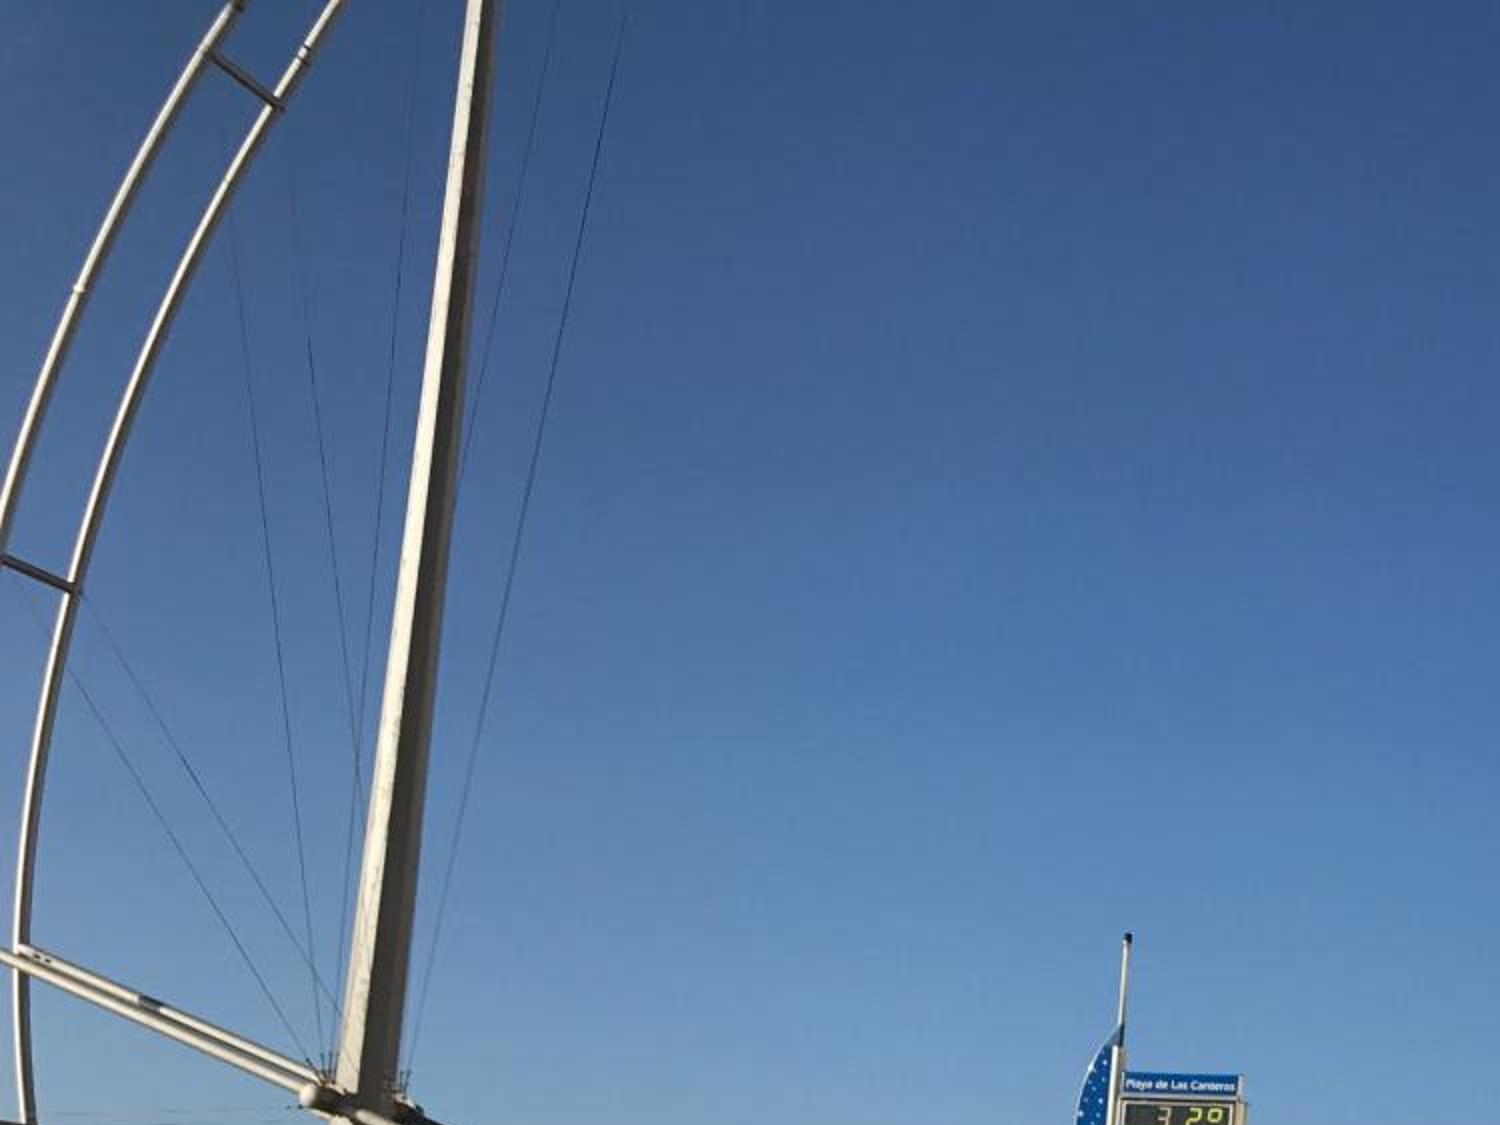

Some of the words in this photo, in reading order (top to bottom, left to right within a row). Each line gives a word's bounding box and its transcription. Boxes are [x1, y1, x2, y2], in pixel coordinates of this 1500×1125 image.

[1125, 1079, 1153, 1092] Playa
[1155, 1079, 1168, 1090] de
[1171, 1080, 1188, 1091] Las
[1190, 1081, 1236, 1092] Canteras
